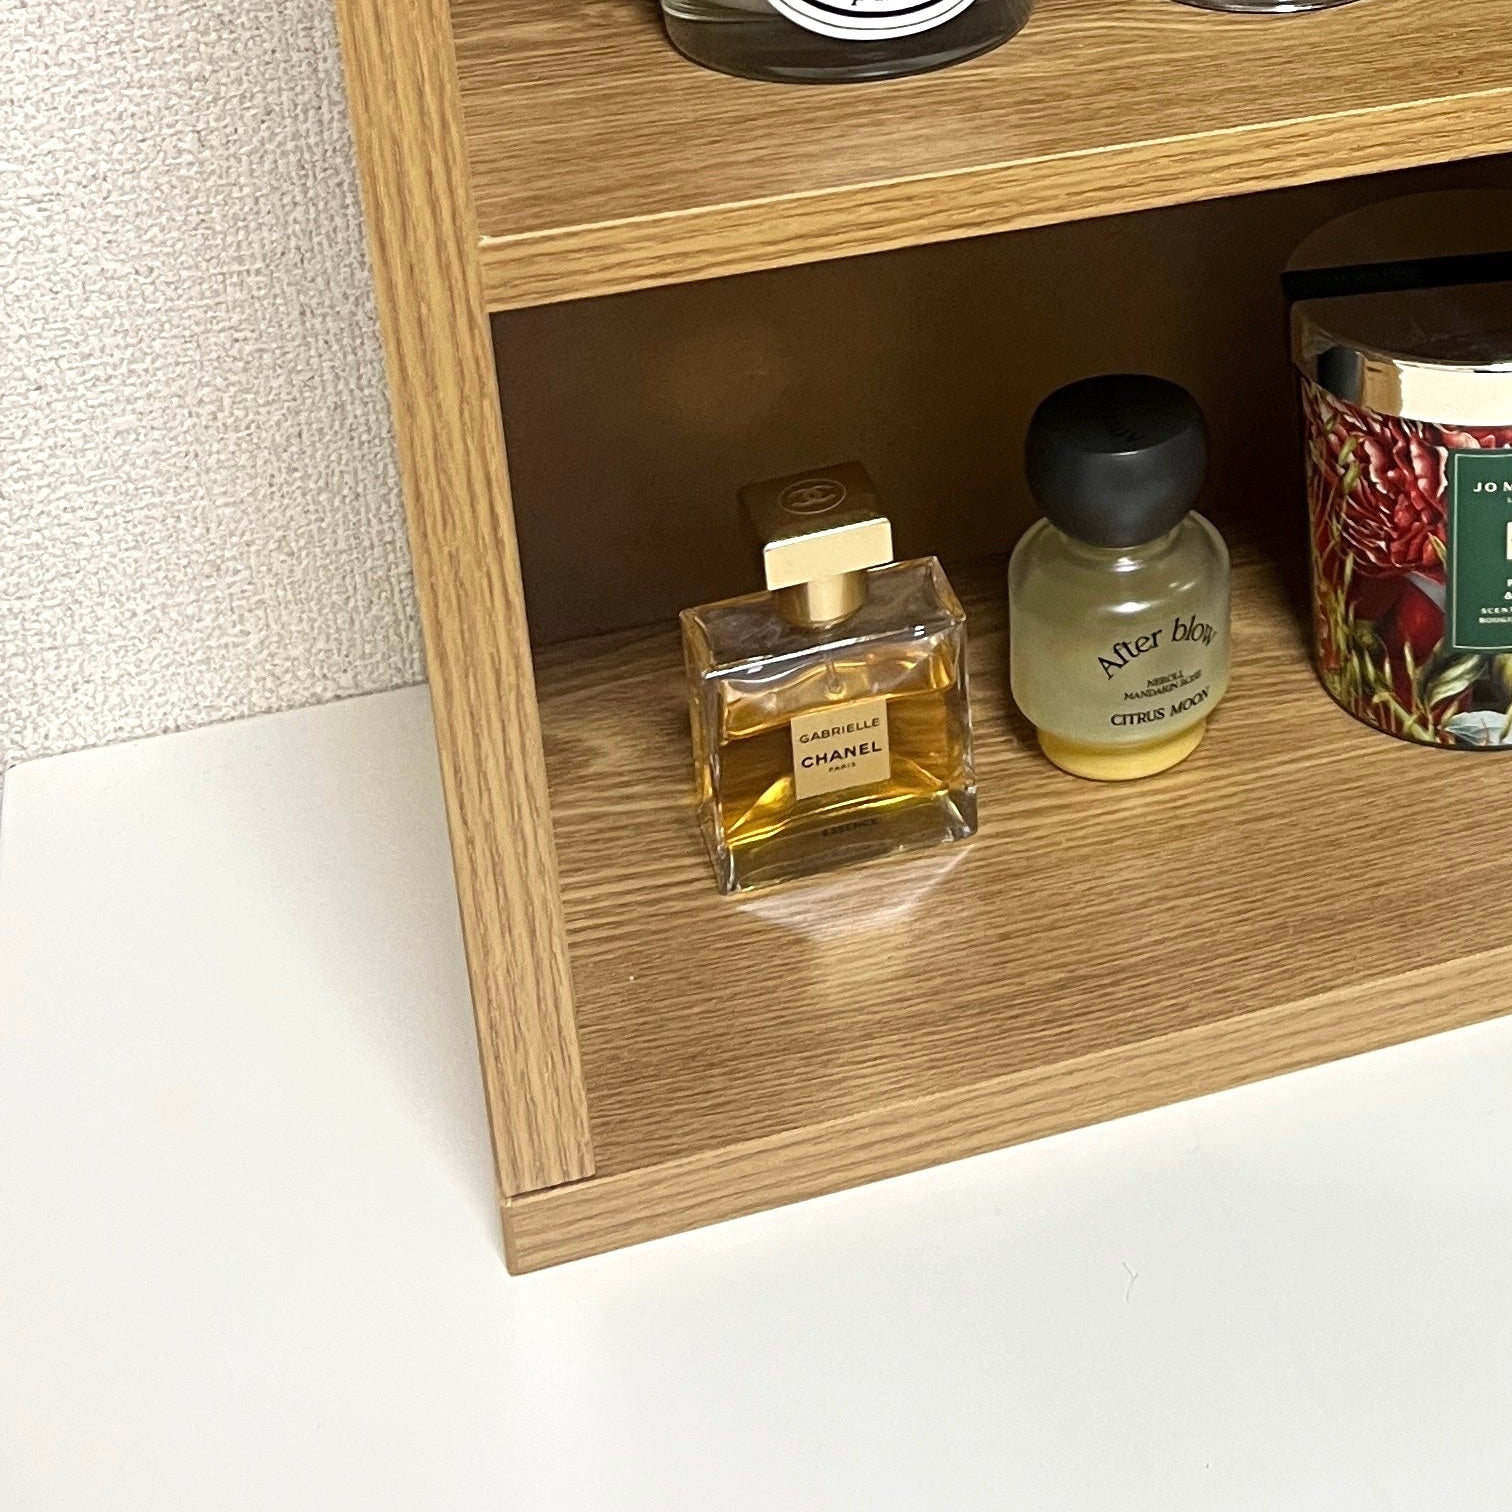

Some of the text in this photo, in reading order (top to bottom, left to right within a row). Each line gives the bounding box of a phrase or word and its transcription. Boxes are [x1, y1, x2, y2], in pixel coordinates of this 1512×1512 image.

[1473, 482, 1497, 493] JO
[1503, 591, 1512, 600] &
[1098, 629, 1163, 681] After
[1171, 614, 1217, 647] blow
[1111, 685, 1210, 726] CITRUS MOON
[799, 717, 880, 744] GABRIELLE
[801, 741, 882, 768] CHANEL
[829, 762, 856, 772] PARIS
